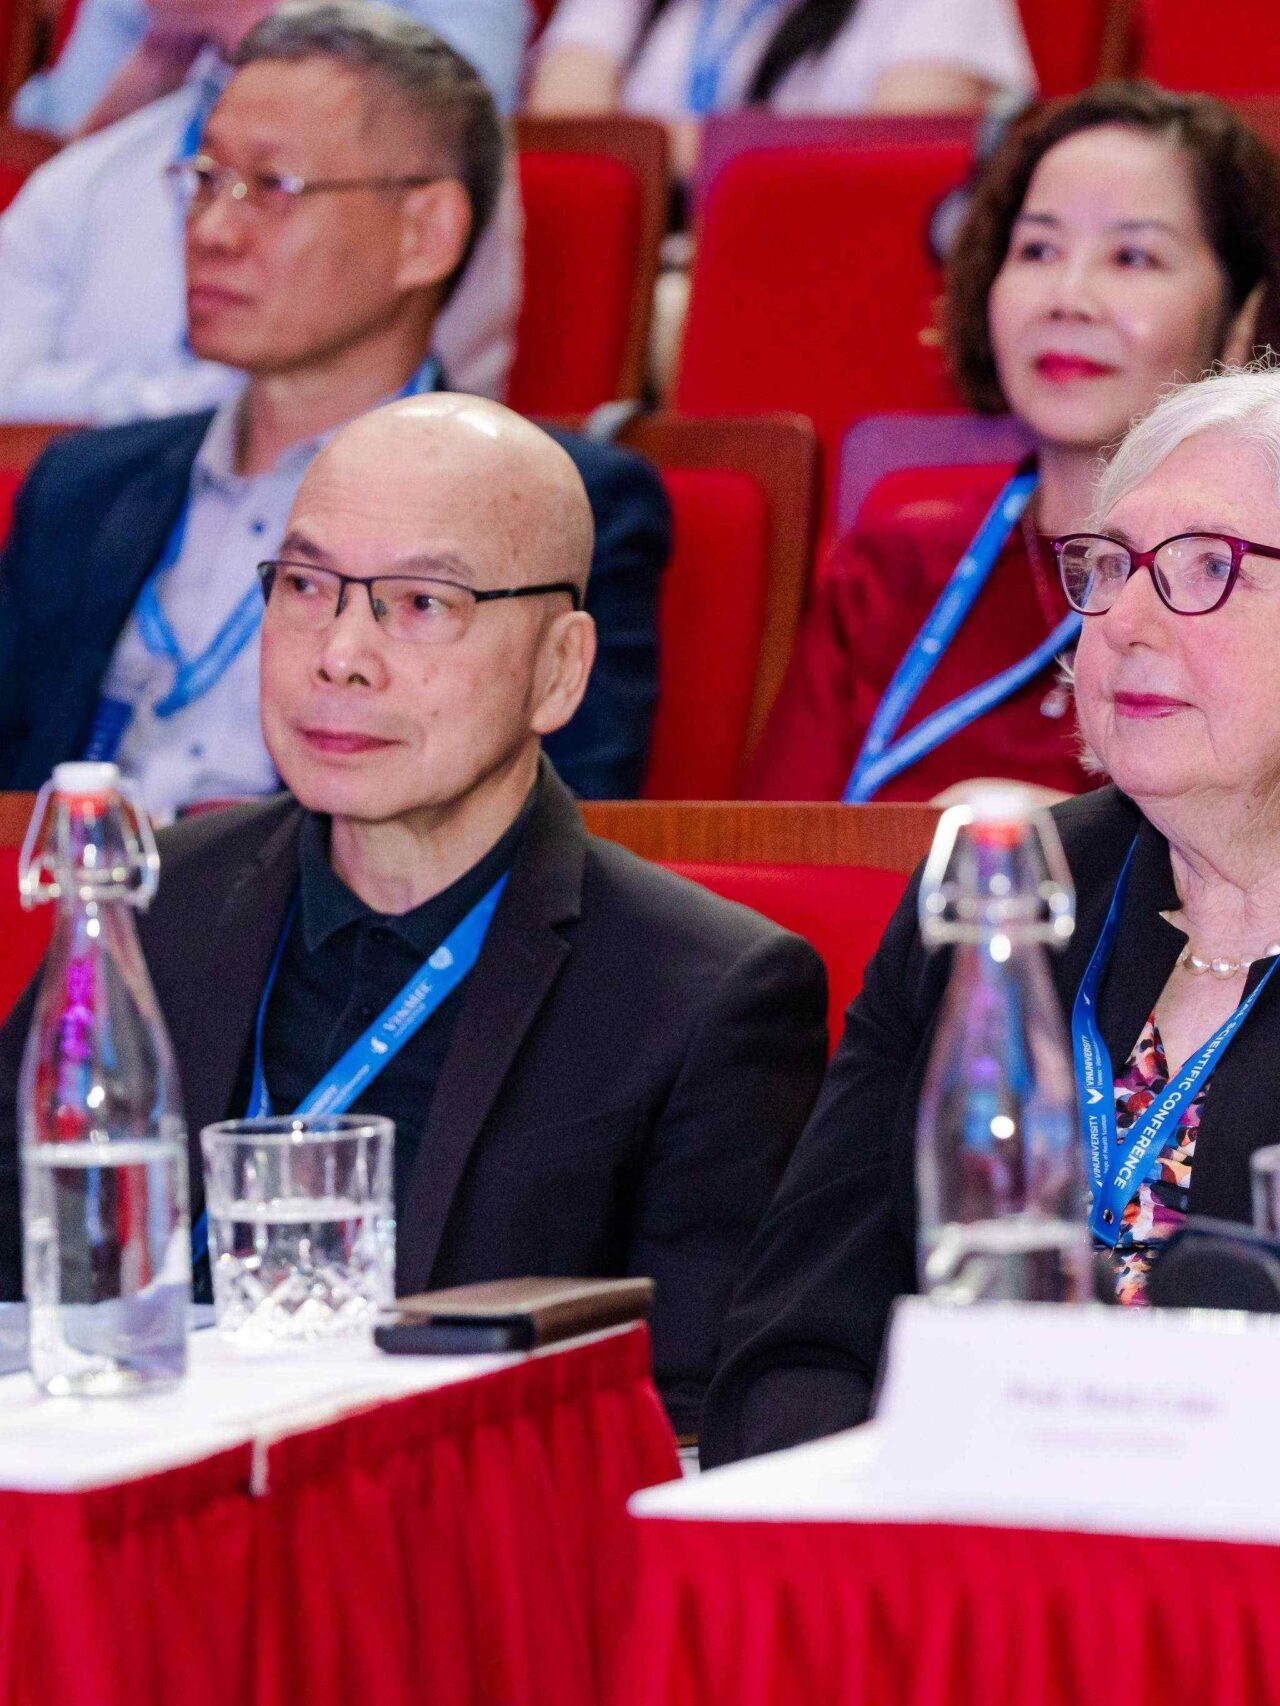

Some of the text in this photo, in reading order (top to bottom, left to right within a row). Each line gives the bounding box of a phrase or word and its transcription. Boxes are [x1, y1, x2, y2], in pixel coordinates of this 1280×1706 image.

[1081, 1034, 1095, 1087] VINUNIVERSITY
[1178, 1022, 1237, 1091] SCIENTIFIC
[1088, 1114, 1102, 1179] VINUNIVERSITY
[1114, 1092, 1182, 1190] CONFERENCE
